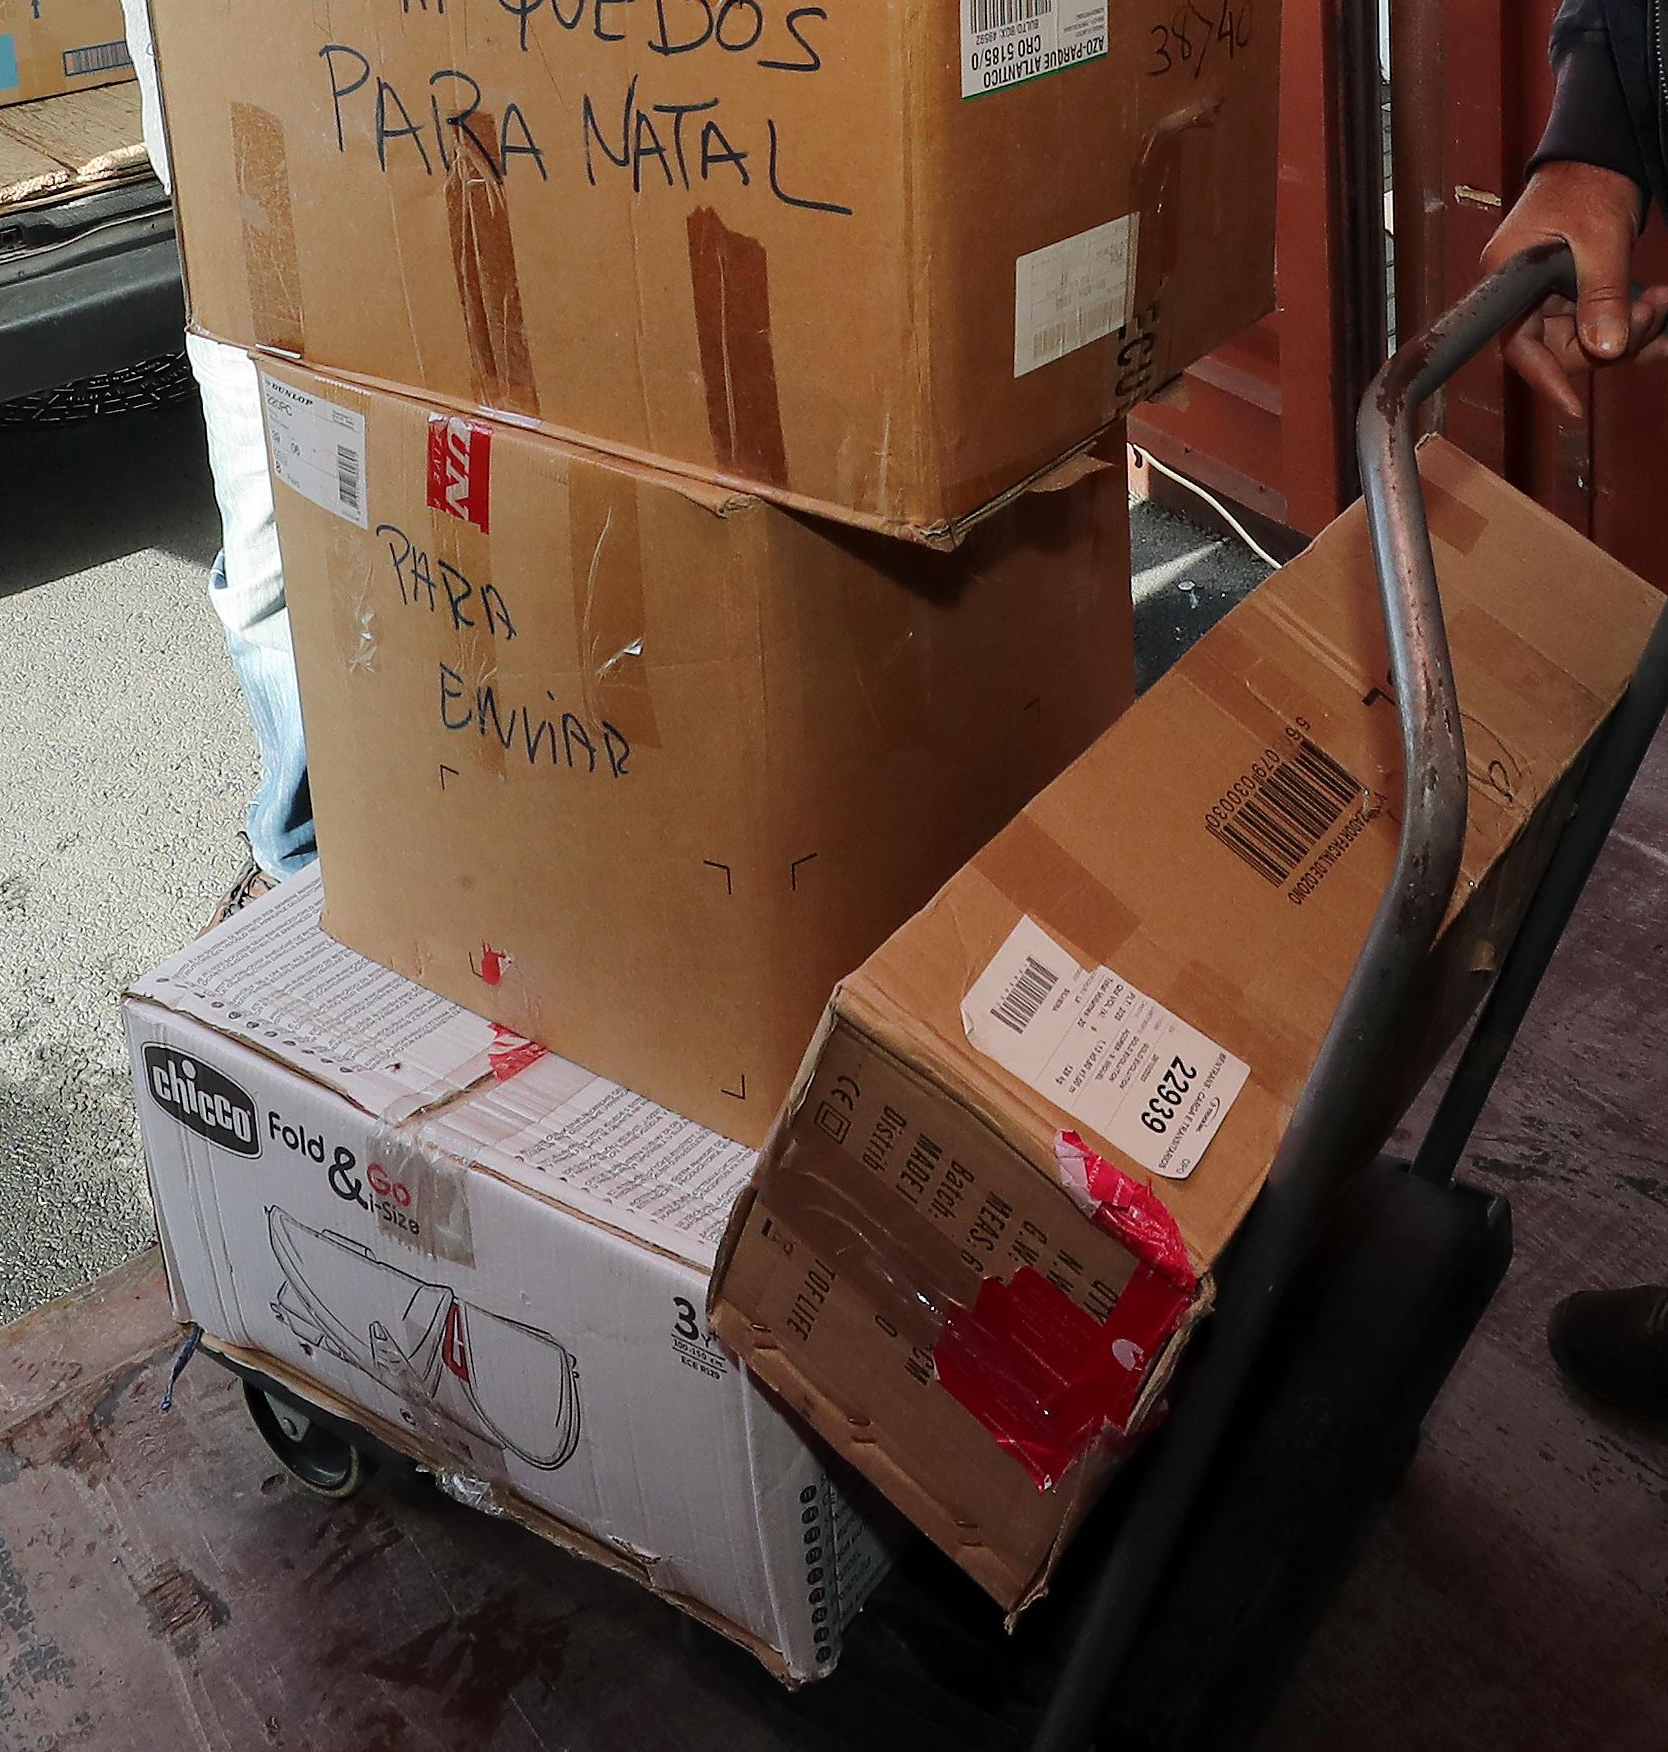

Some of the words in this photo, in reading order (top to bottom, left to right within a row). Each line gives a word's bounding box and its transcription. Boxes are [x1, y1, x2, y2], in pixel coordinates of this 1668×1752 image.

[1017, 19, 1038, 33] BULTO
[971, 42, 1014, 71] 5185/0
[1018, 34, 1041, 57] CRO
[1044, 36, 1104, 69] AZO-PARQUE
[983, 56, 1041, 88] ATLANTICO
[318, 43, 548, 183] PARA
[583, 75, 853, 216] NATAL
[271, 383, 314, 407] DUNLOP
[376, 524, 518, 640] PARA
[1316, 834, 1351, 870] FACIAL
[1308, 860, 1328, 880] DE
[1285, 871, 1320, 907] OZONO
[1098, 975, 1114, 993] Total
[1126, 1035, 1140, 1052] GOLD
[1053, 1073, 1066, 1086] kg
[1137, 1055, 1199, 1136] 22939
[151, 1059, 252, 1143] chicco
[1186, 1090, 1206, 1117] CARGA
[267, 1111, 326, 1164] Fold
[328, 1145, 369, 1211] &
[366, 1161, 413, 1207] Go
[894, 1133, 946, 1194] MADE
[925, 1160, 978, 1225] Batch:
[367, 1193, 421, 1236] i-Size
[804, 1270, 830, 1304] OF
[786, 1293, 819, 1342] LIFE
[681, 1356, 698, 1369] ECE
